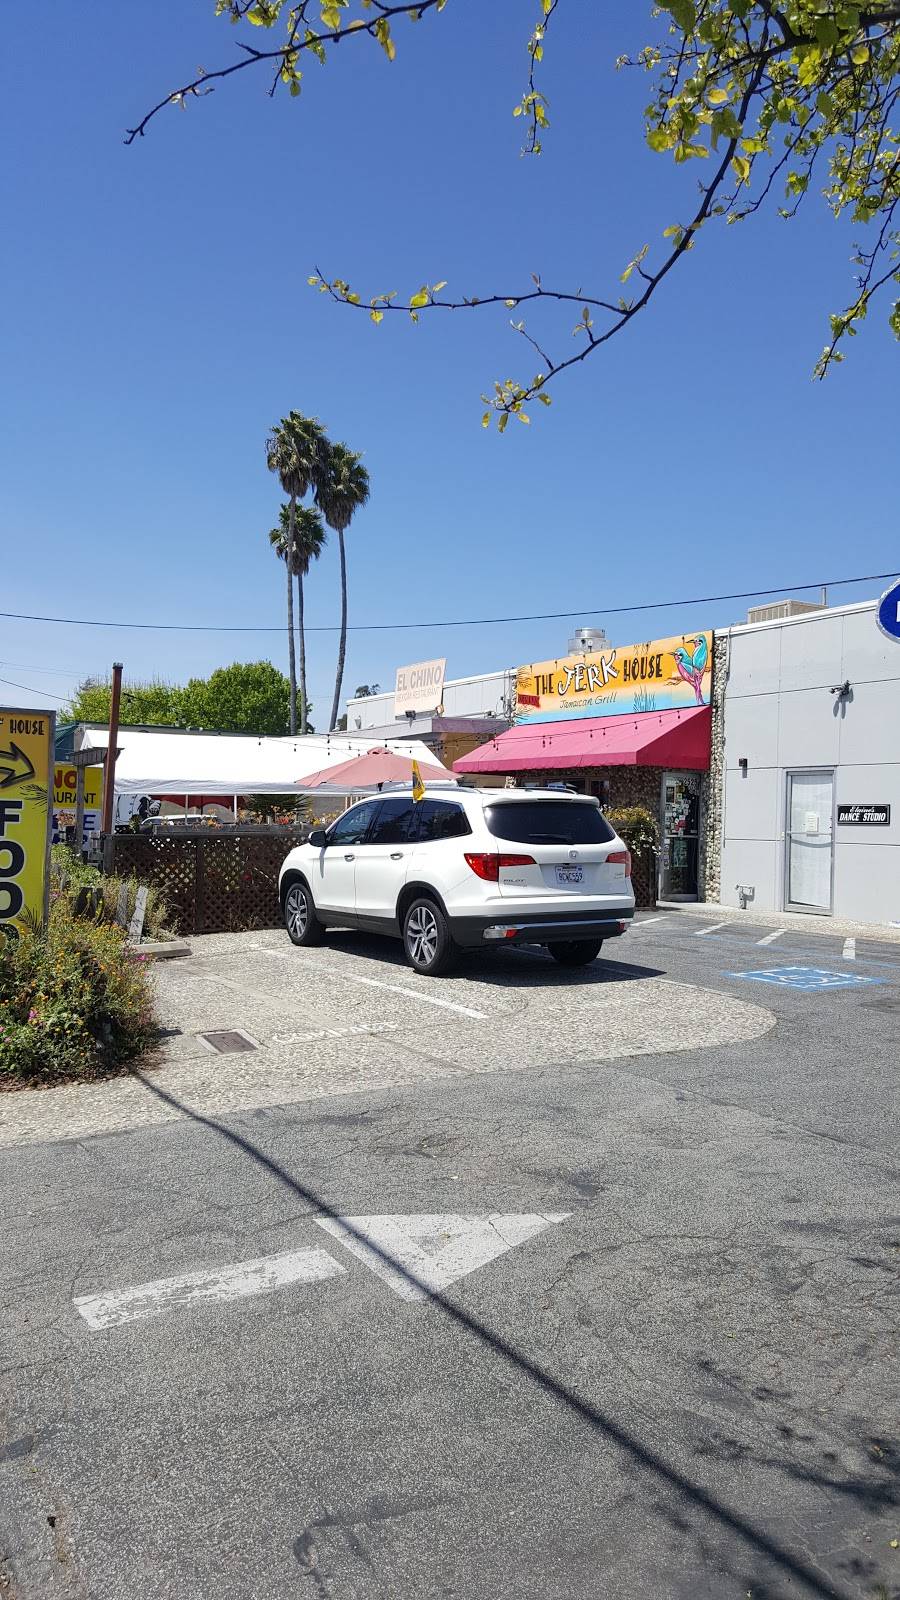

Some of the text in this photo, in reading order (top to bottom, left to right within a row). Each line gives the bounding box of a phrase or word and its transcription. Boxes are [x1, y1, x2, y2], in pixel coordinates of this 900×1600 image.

[397, 665, 442, 691] EL CHINO
[534, 650, 664, 696] THE JERK HOUSE
[594, 691, 617, 705] Grill
[9, 719, 45, 736] HOUSE
[839, 812, 886, 822] DANCE STUDIO
